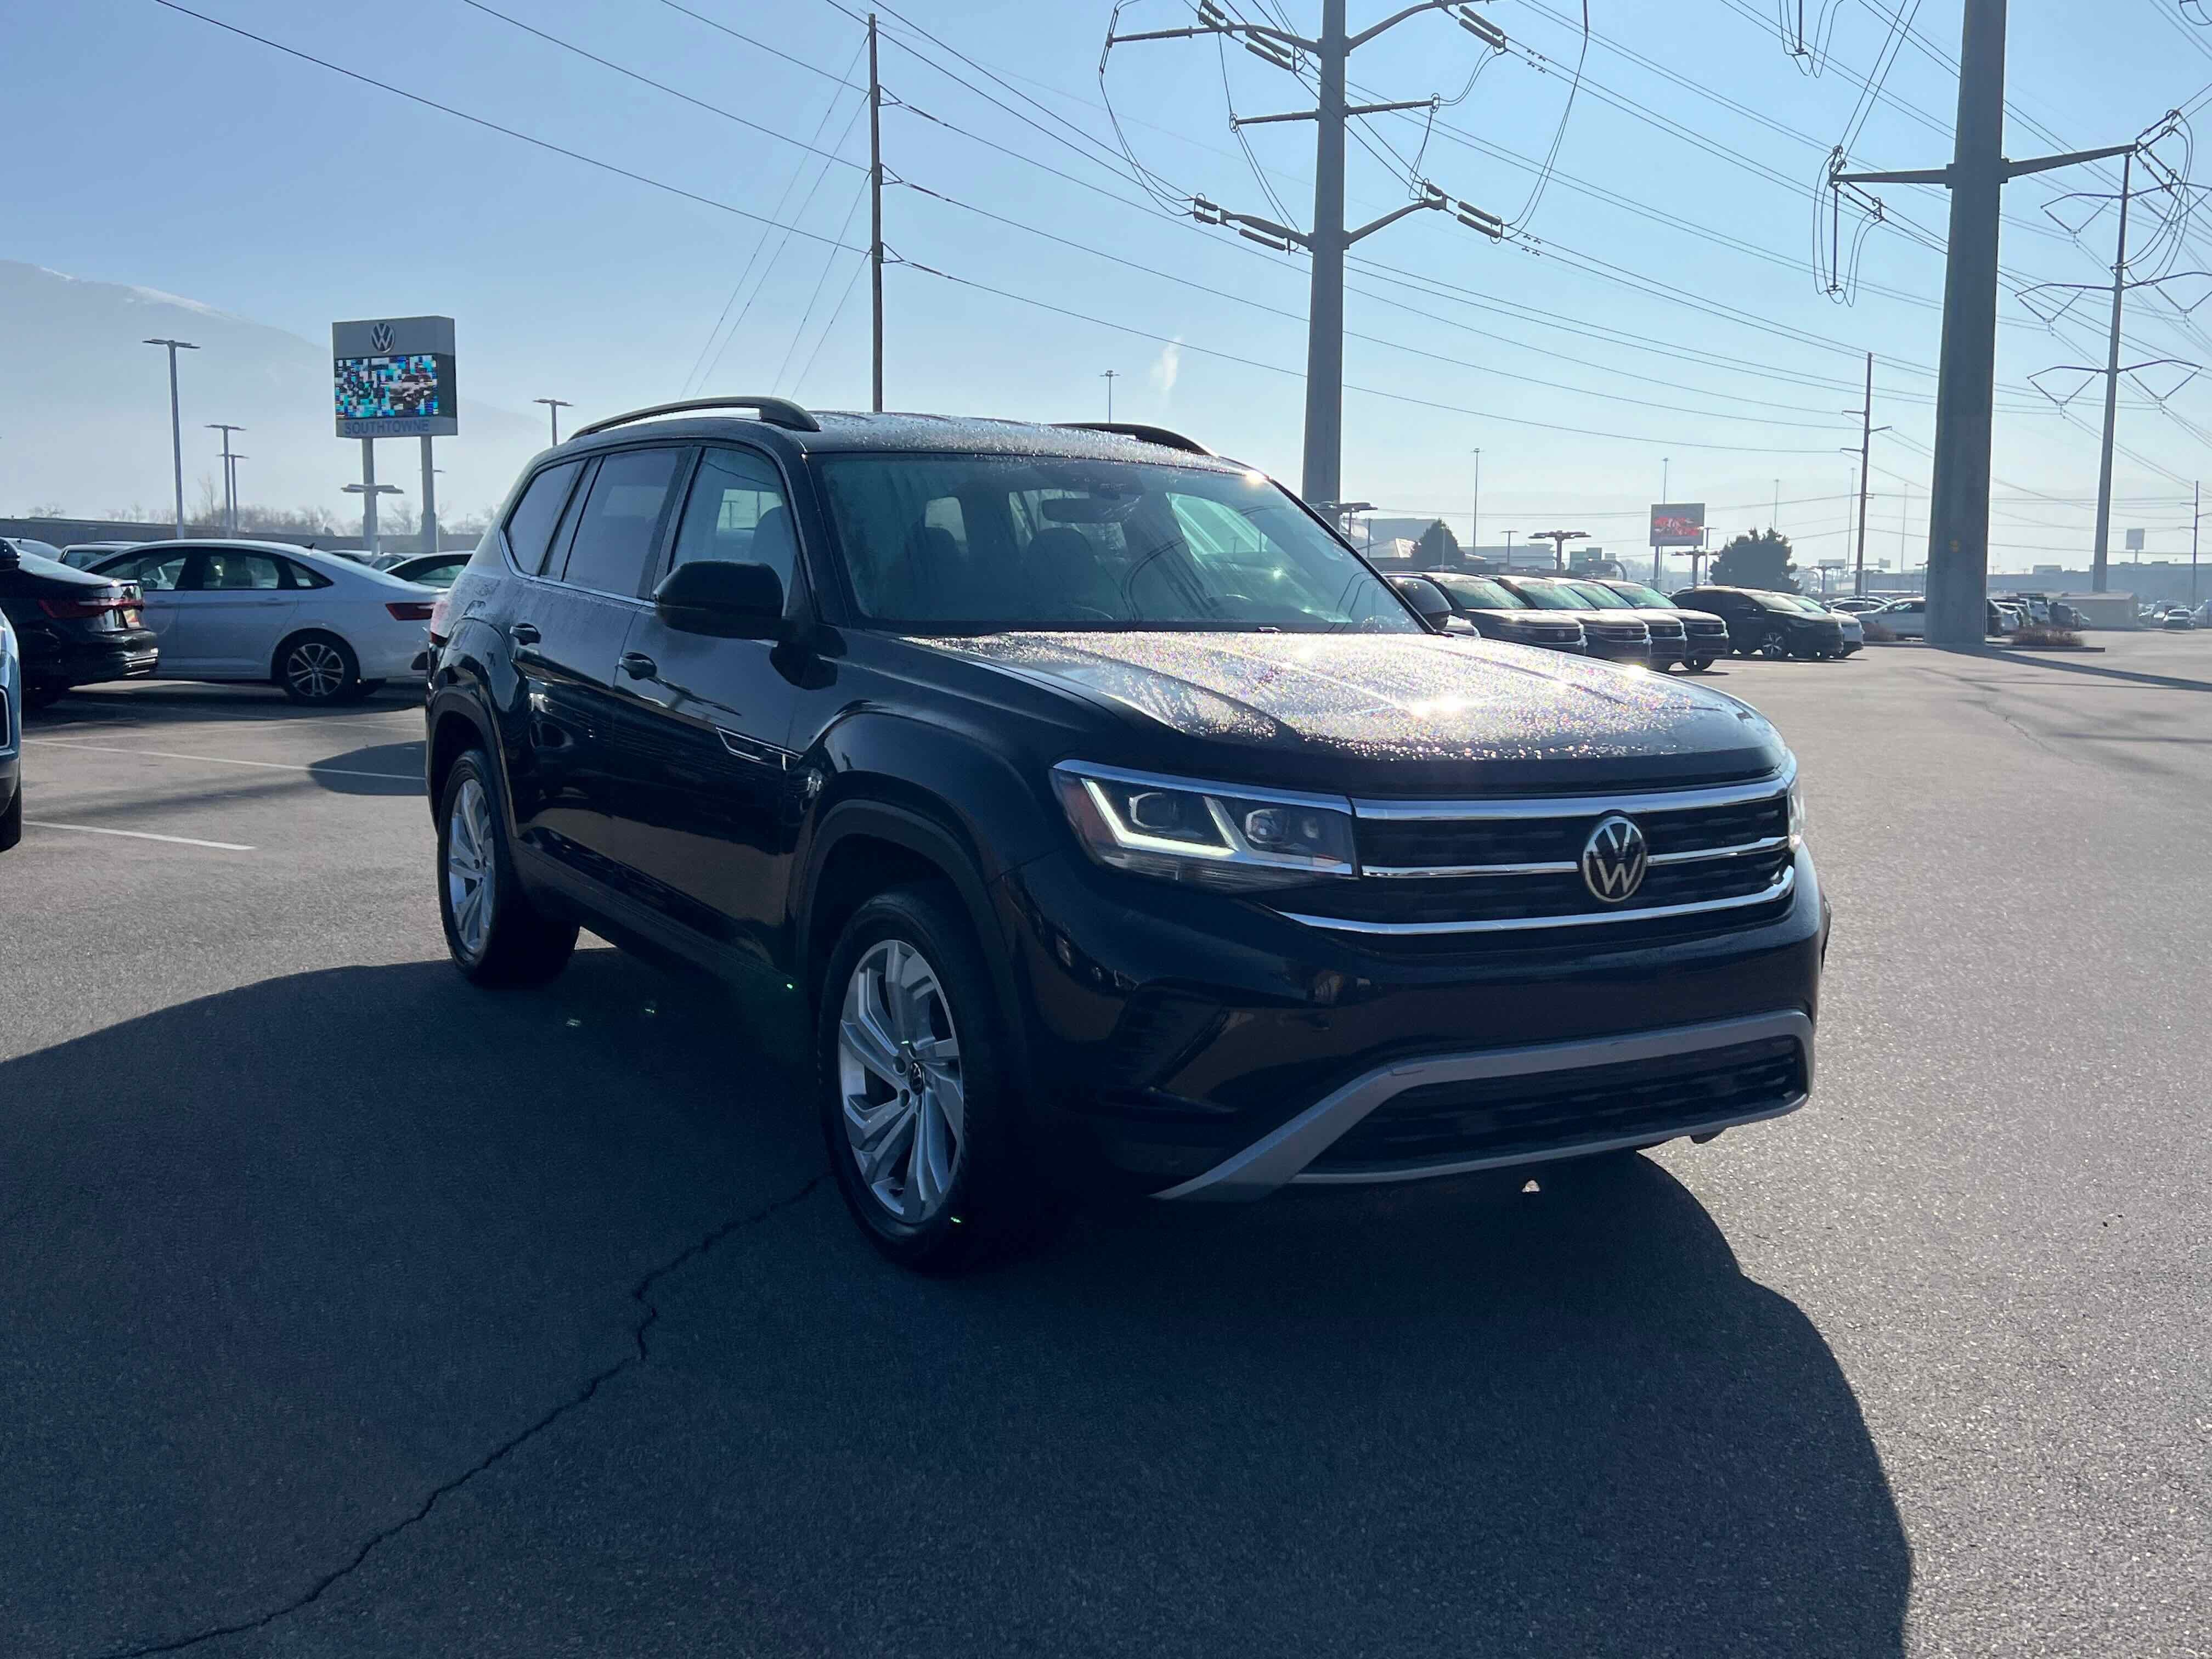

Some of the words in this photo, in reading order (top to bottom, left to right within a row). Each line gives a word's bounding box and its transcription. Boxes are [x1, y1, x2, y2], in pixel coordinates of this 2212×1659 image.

[371, 323, 395, 353] VW
[344, 419, 430, 435] SOUTHTOWNE
[1583, 816, 1646, 902] VW
